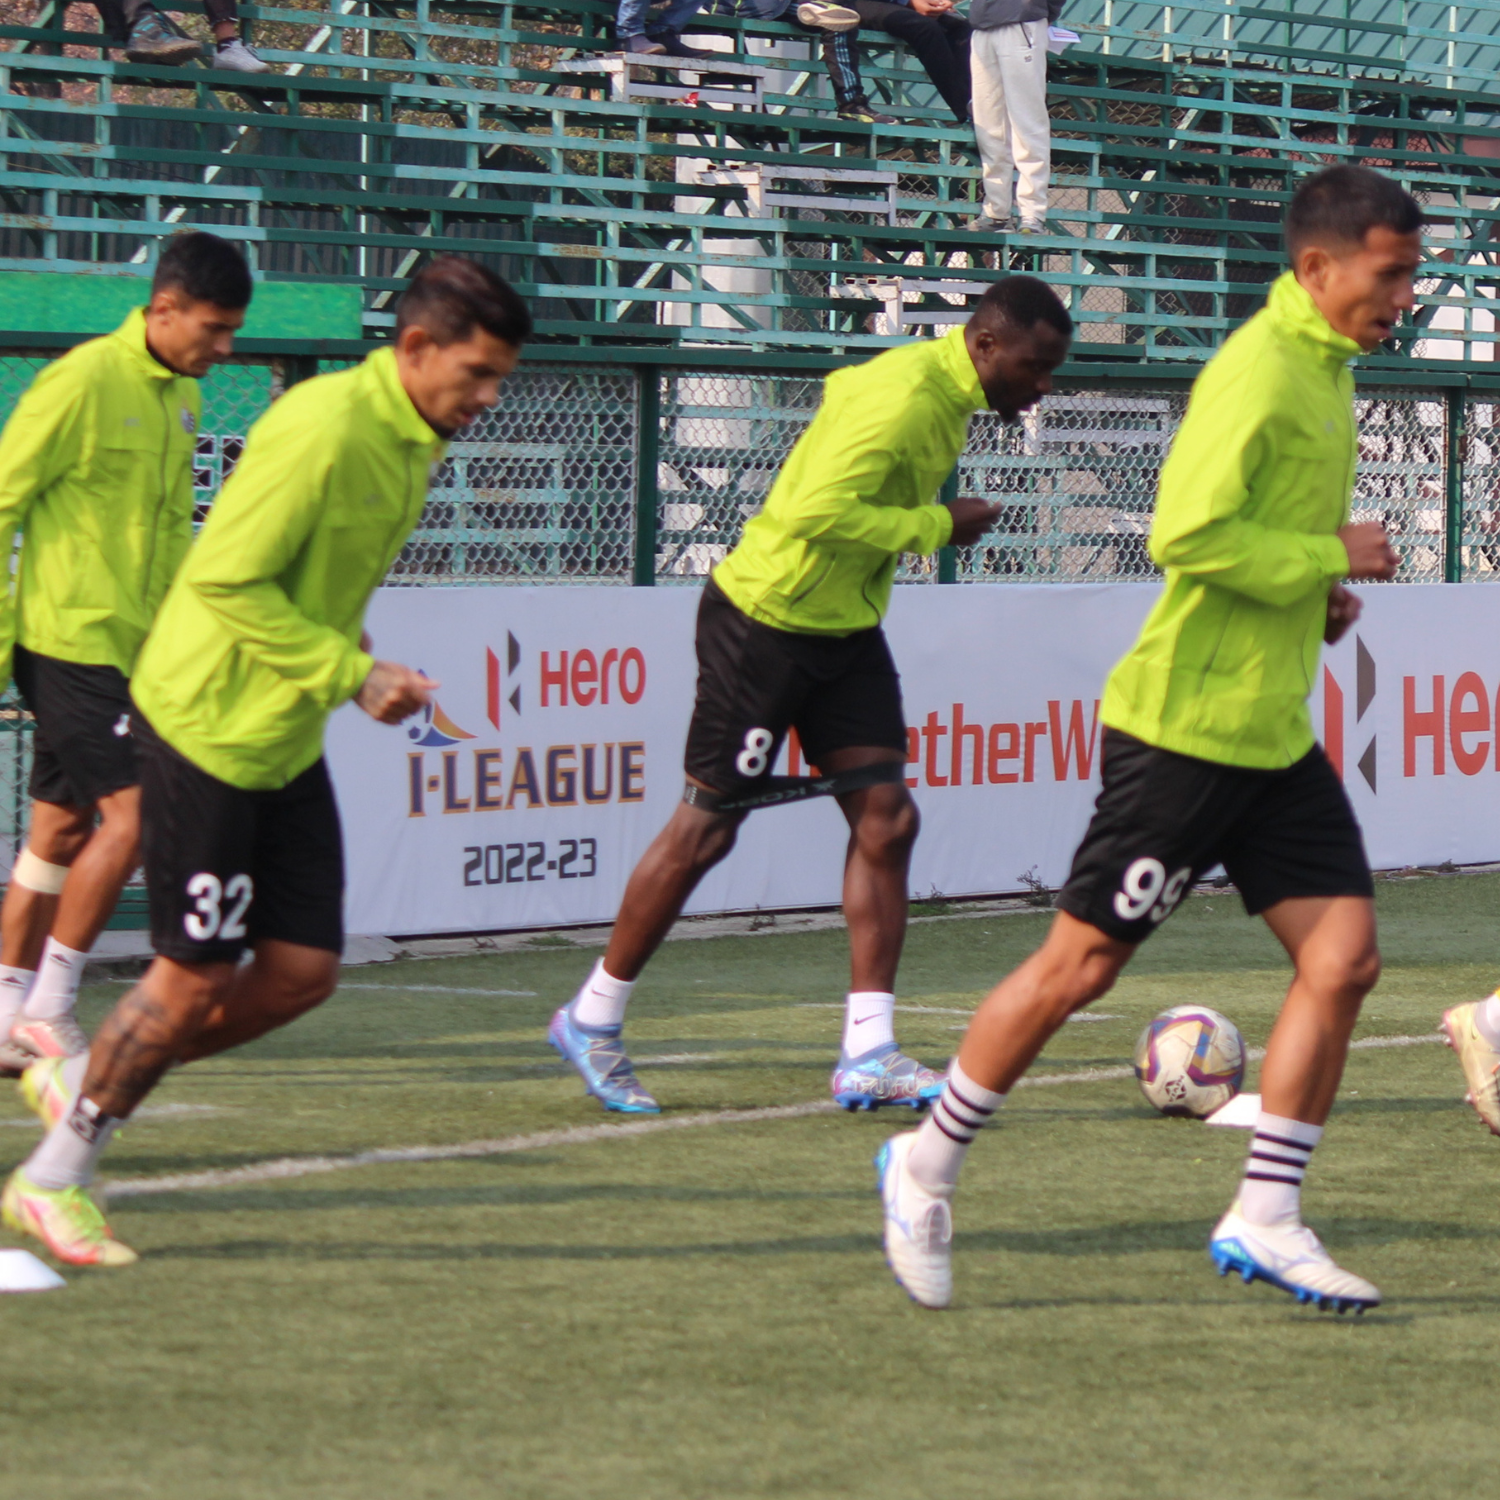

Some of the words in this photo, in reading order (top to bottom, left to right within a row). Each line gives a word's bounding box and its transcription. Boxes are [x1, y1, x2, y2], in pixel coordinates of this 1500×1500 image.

[540, 647, 646, 707] Hero
[407, 741, 646, 818] I-LEAGUE
[736, 727, 773, 777] 8
[464, 837, 597, 887] 2022-23
[1113, 856, 1192, 922] 99
[184, 872, 254, 940] 32
